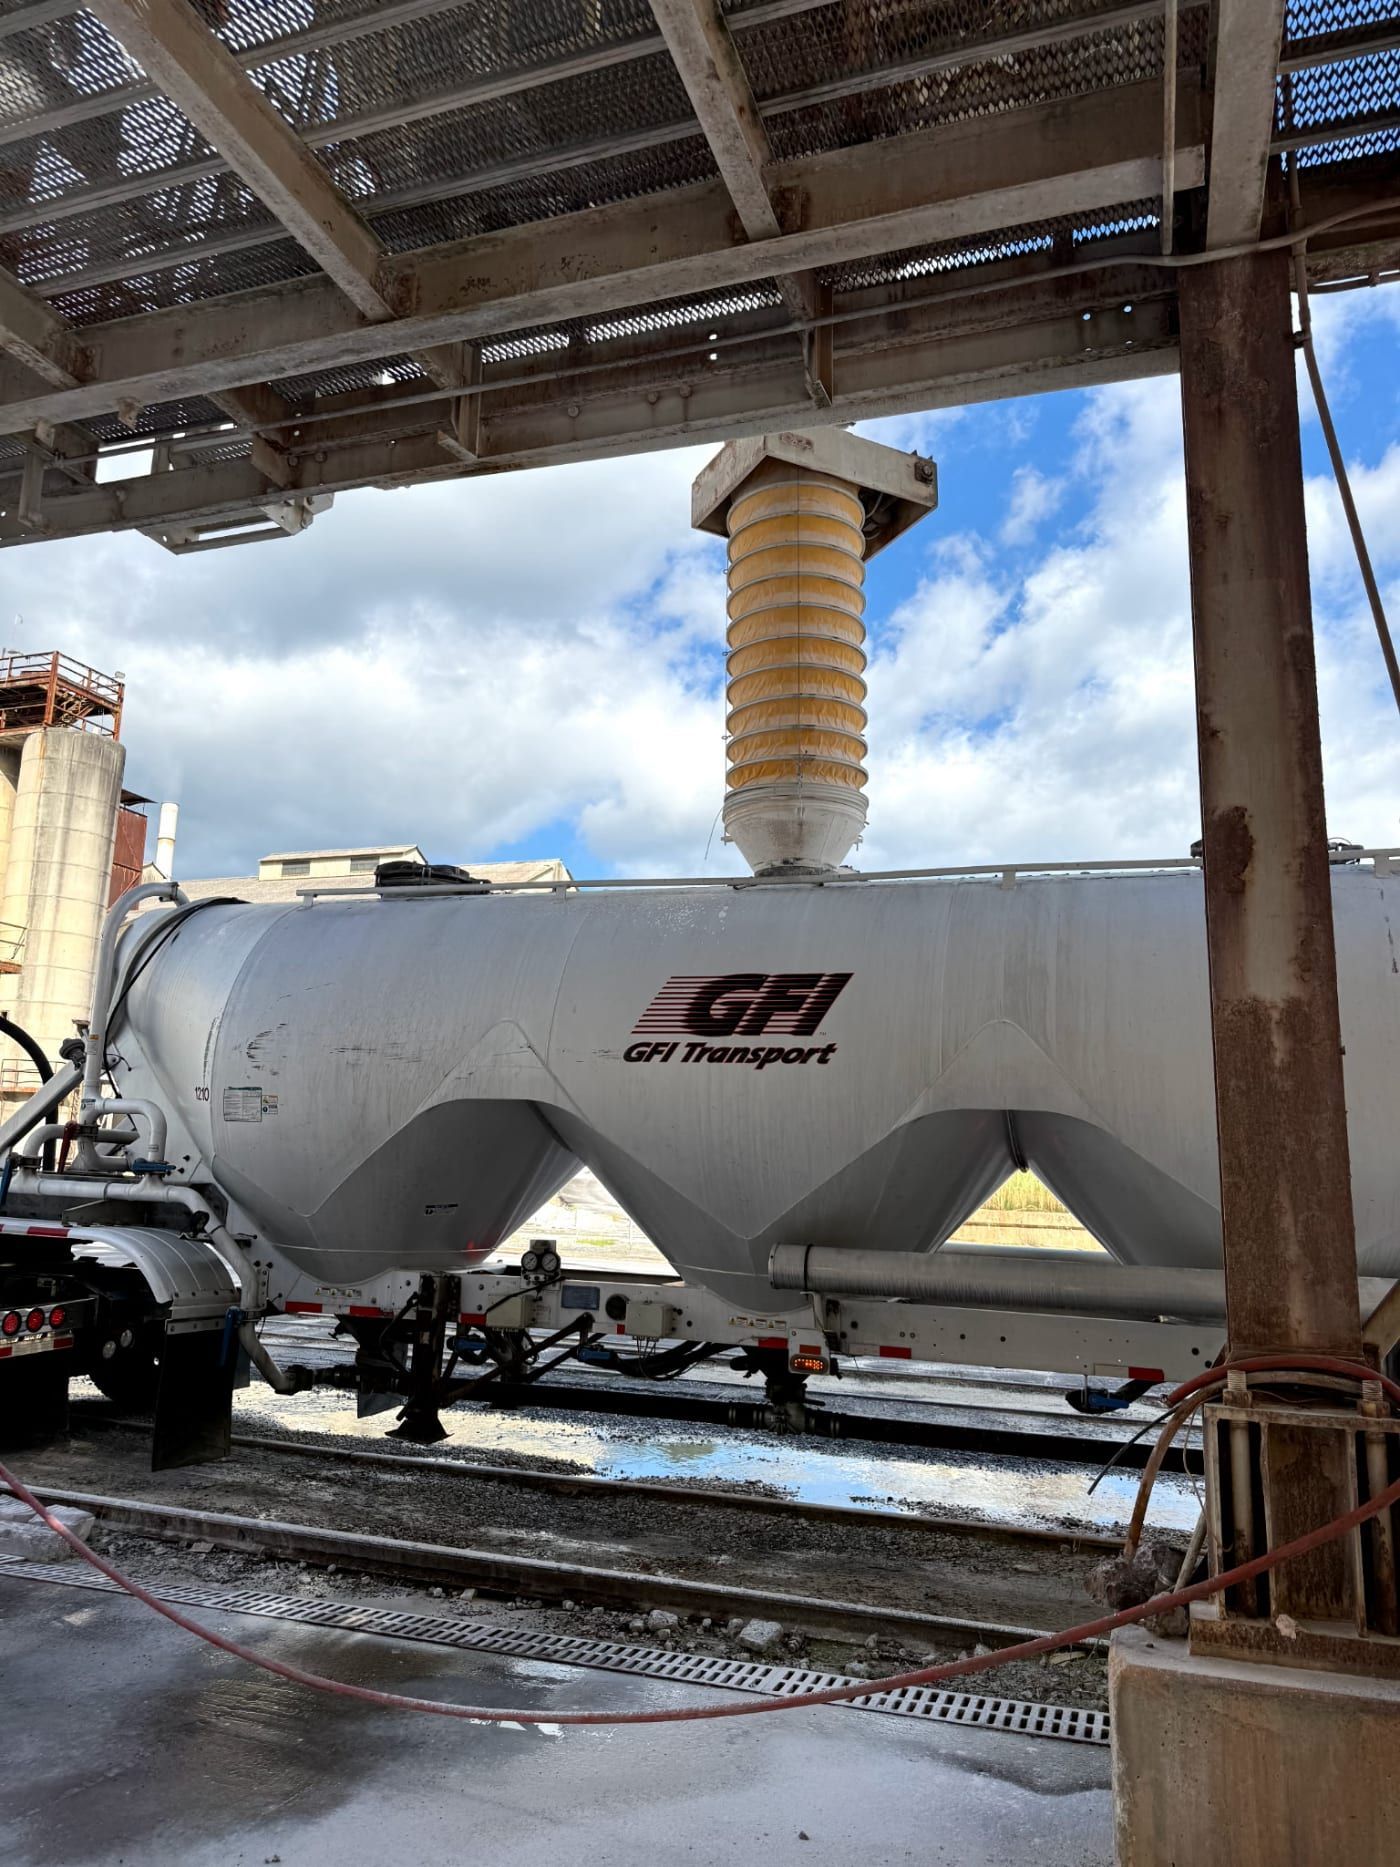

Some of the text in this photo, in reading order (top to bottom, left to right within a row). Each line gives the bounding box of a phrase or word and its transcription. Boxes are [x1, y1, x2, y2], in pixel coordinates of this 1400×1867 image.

[680, 972, 854, 1037] GFI
[623, 1042, 837, 1070] GFI Transport
[194, 1086, 209, 1101] 1210
